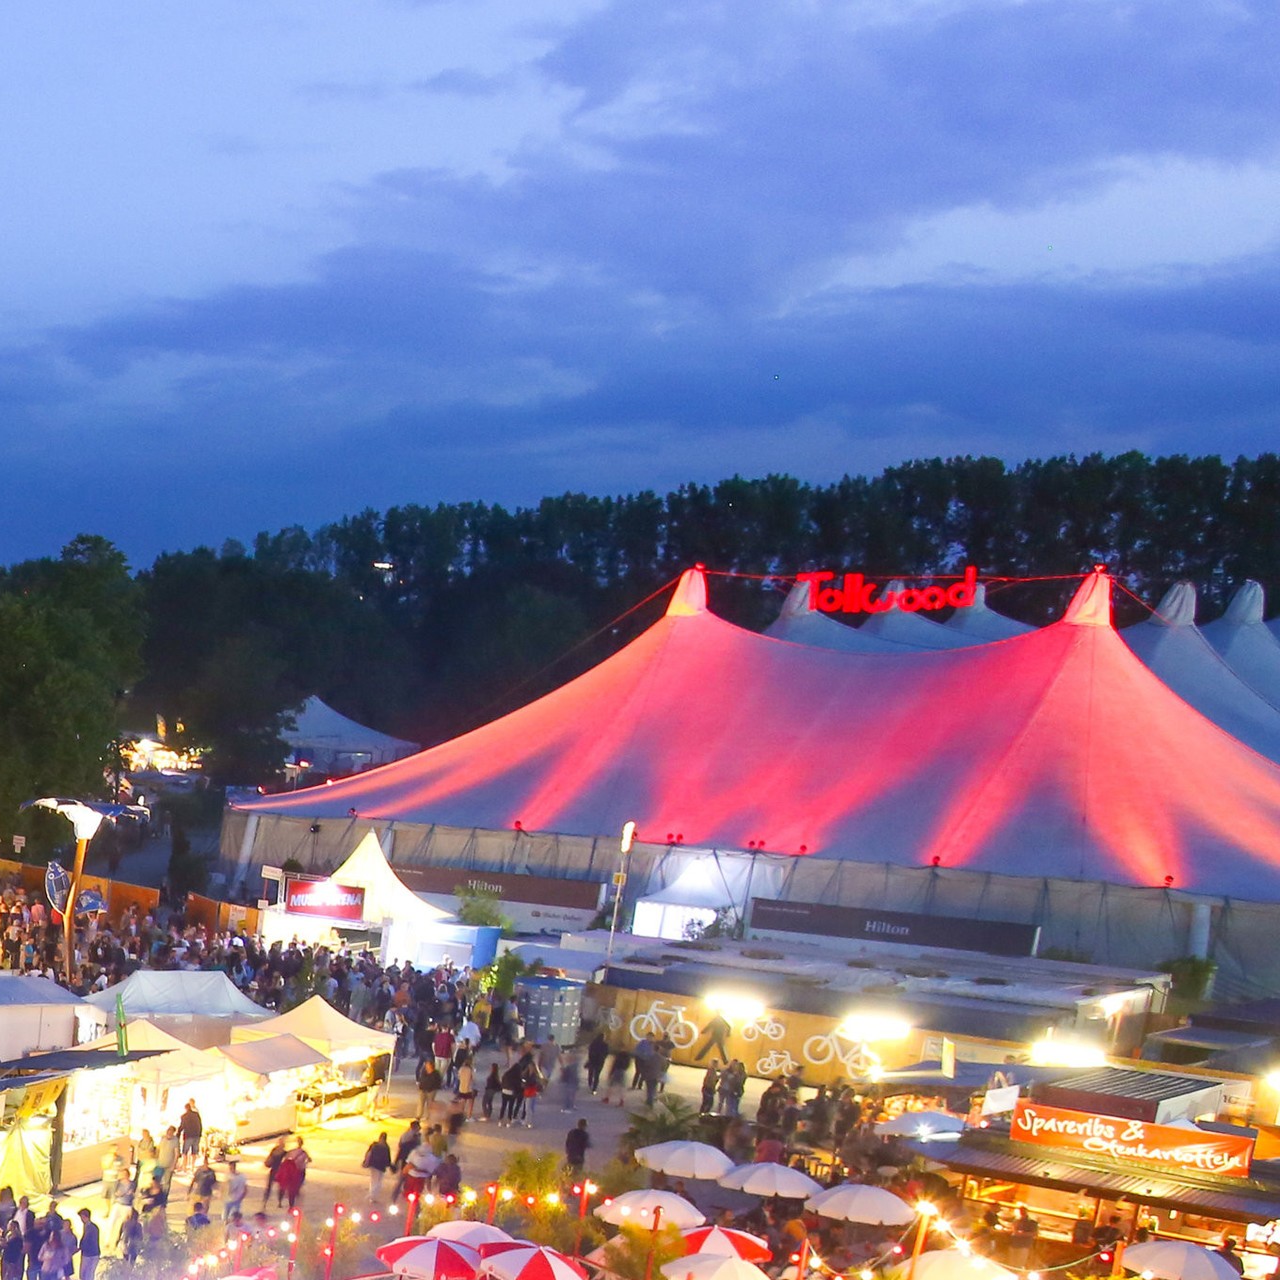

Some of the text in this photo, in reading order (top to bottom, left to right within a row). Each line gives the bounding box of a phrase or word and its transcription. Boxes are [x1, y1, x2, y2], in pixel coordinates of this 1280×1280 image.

[796, 565, 977, 614] Tollwood
[468, 880, 503, 893] Hilton
[864, 920, 910, 936] Hilton
[1017, 1108, 1145, 1142] Spareribs &
[1083, 1137, 1243, 1170] Ofenkartoffeln
